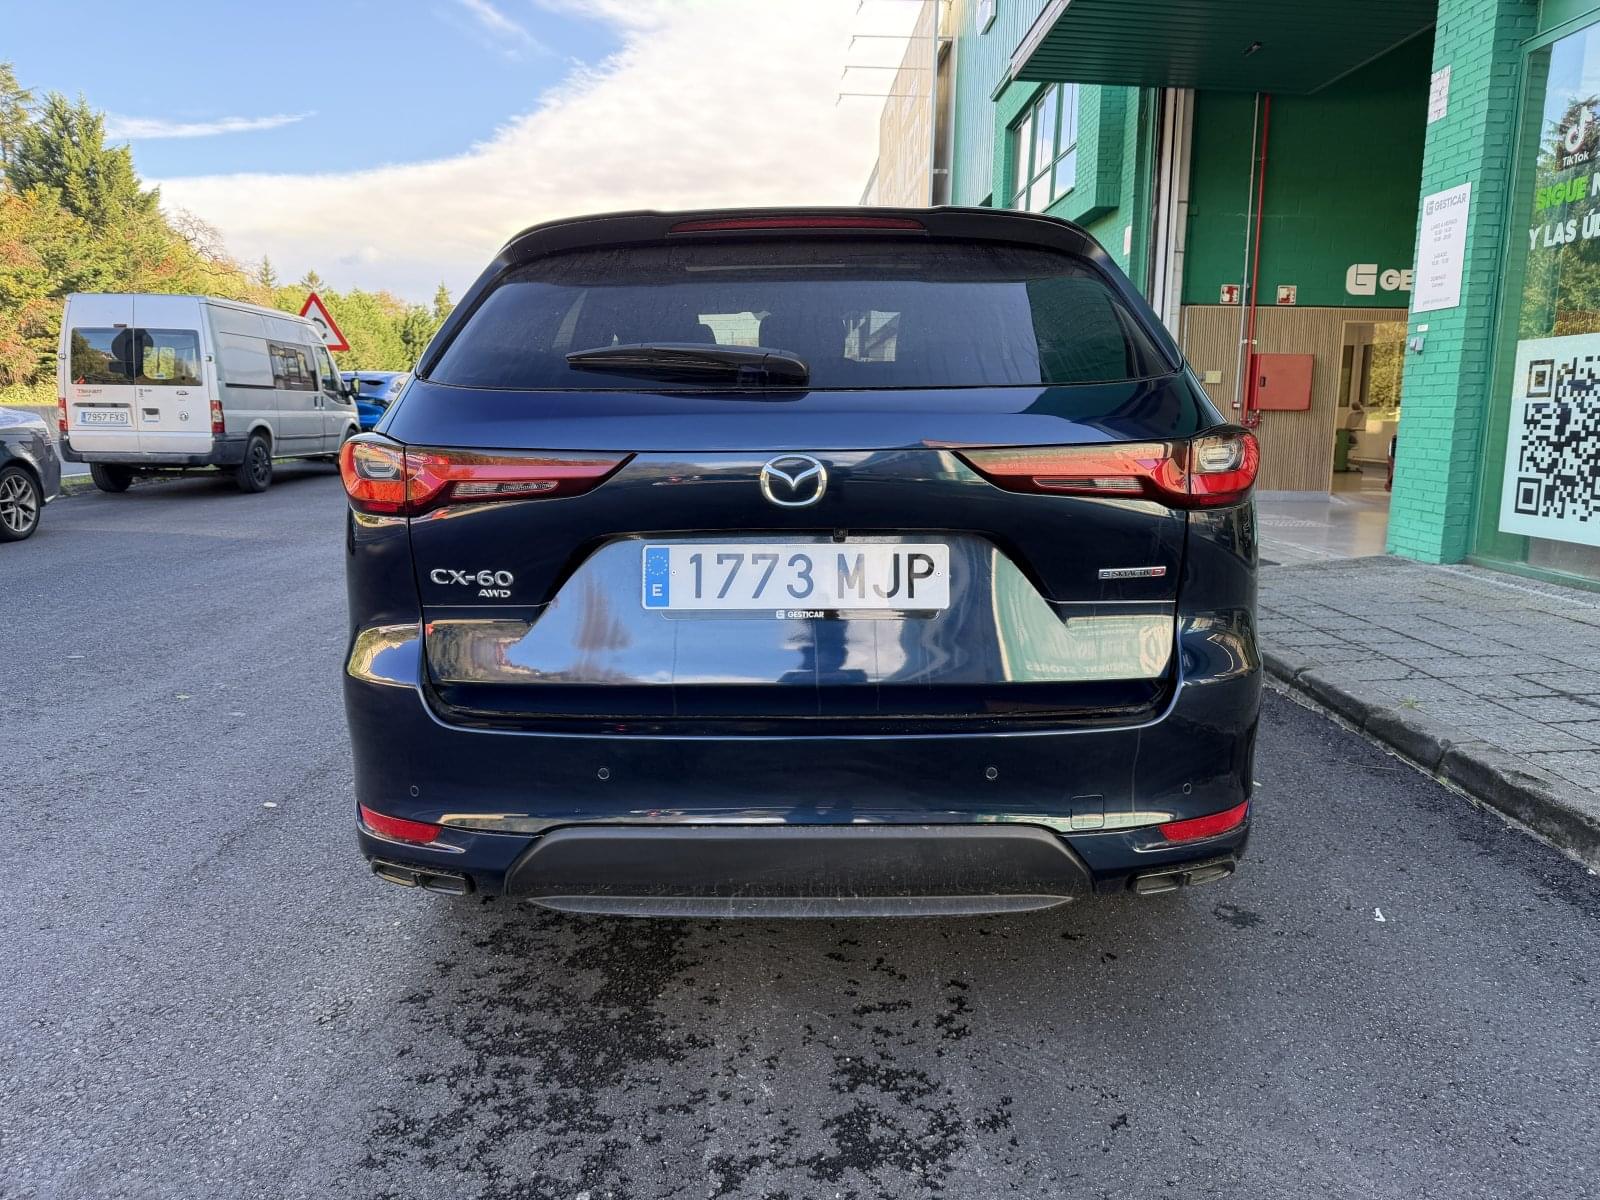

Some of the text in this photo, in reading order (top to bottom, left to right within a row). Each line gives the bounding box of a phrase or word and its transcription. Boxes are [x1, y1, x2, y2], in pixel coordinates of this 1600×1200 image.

[1563, 151, 1589, 167] TikTok
[1434, 193, 1467, 211] GESTICAR
[1536, 175, 1589, 210] SIGUE
[1529, 208, 1600, 250] Y LAS ÚL
[1379, 268, 1413, 291] GE
[430, 568, 514, 587] CX-60
[689, 553, 935, 599] 1773 MJP
[478, 589, 511, 598] AWD
[652, 583, 663, 597] E
